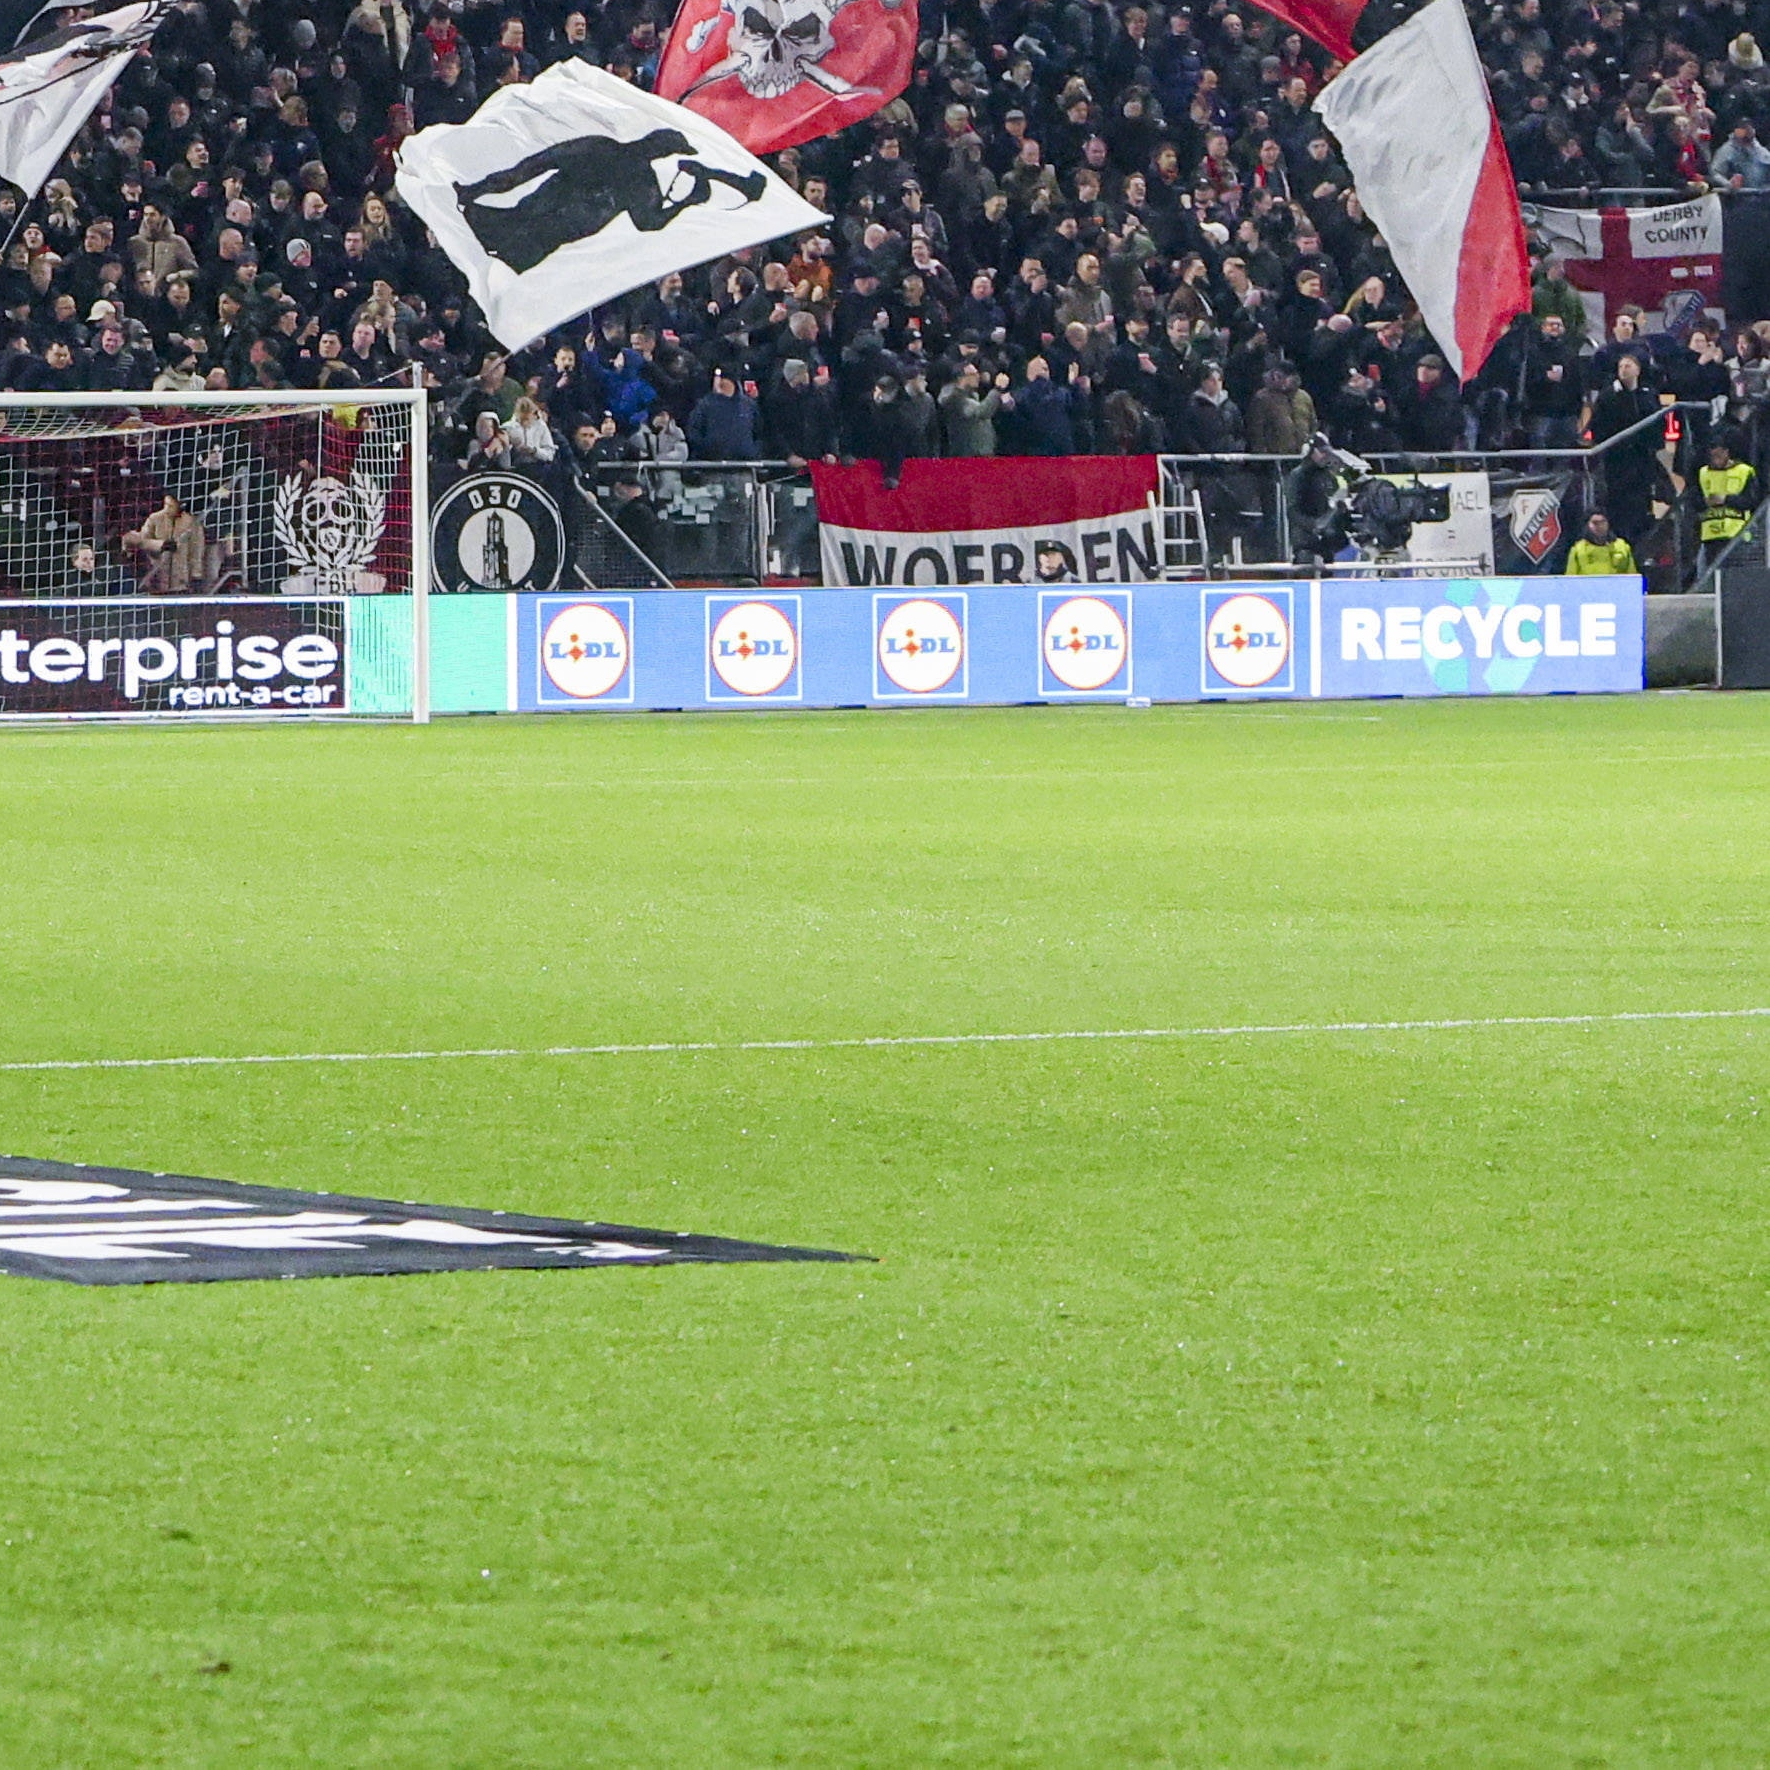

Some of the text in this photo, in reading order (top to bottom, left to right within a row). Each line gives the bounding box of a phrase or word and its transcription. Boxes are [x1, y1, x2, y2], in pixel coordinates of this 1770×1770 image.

[1653, 204, 1703, 223] DERBY
[1644, 226, 1709, 244] COUNTY
[1341, 603, 1617, 661] RECYCLE
[168, 682, 338, 706] rent-a-car
